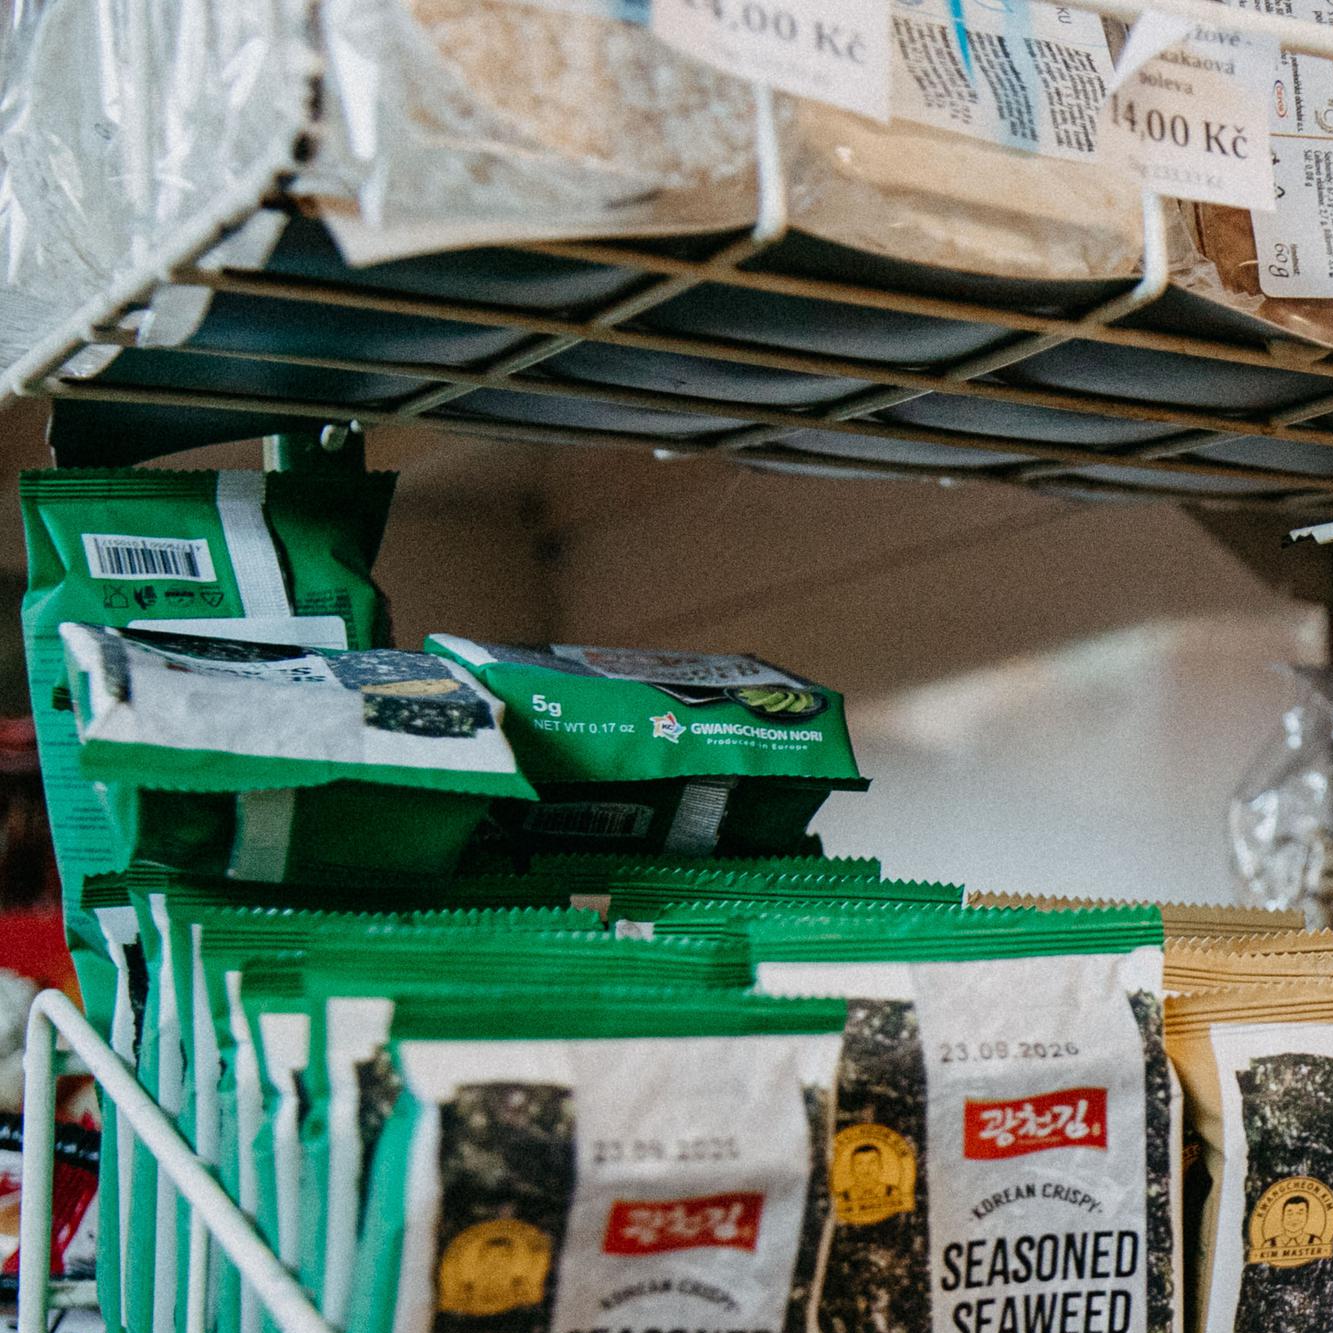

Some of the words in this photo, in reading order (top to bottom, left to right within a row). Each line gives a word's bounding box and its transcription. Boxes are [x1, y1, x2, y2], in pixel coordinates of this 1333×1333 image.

[814, 19, 866, 65] Kč
[1108, 92, 1190, 148] 14,00
[1203, 119, 1249, 160] Kč
[531, 693, 562, 718] 5g
[533, 718, 561, 733] NET
[563, 720, 586, 734] WT
[588, 722, 617, 734] 0.17
[619, 723, 636, 734] oz
[690, 721, 788, 741] GWANGCHEON
[789, 729, 823, 742] NORI
[706, 737, 756, 748] Produced
[771, 743, 808, 751] Europe
[978, 1098, 1091, 1149] 광천김
[970, 1182, 1038, 1221] KOREAN
[1041, 1182, 1102, 1214] CRISPY
[940, 1229, 1140, 1293] SEASONED
[1281, 1246, 1323, 1259] MASTER
